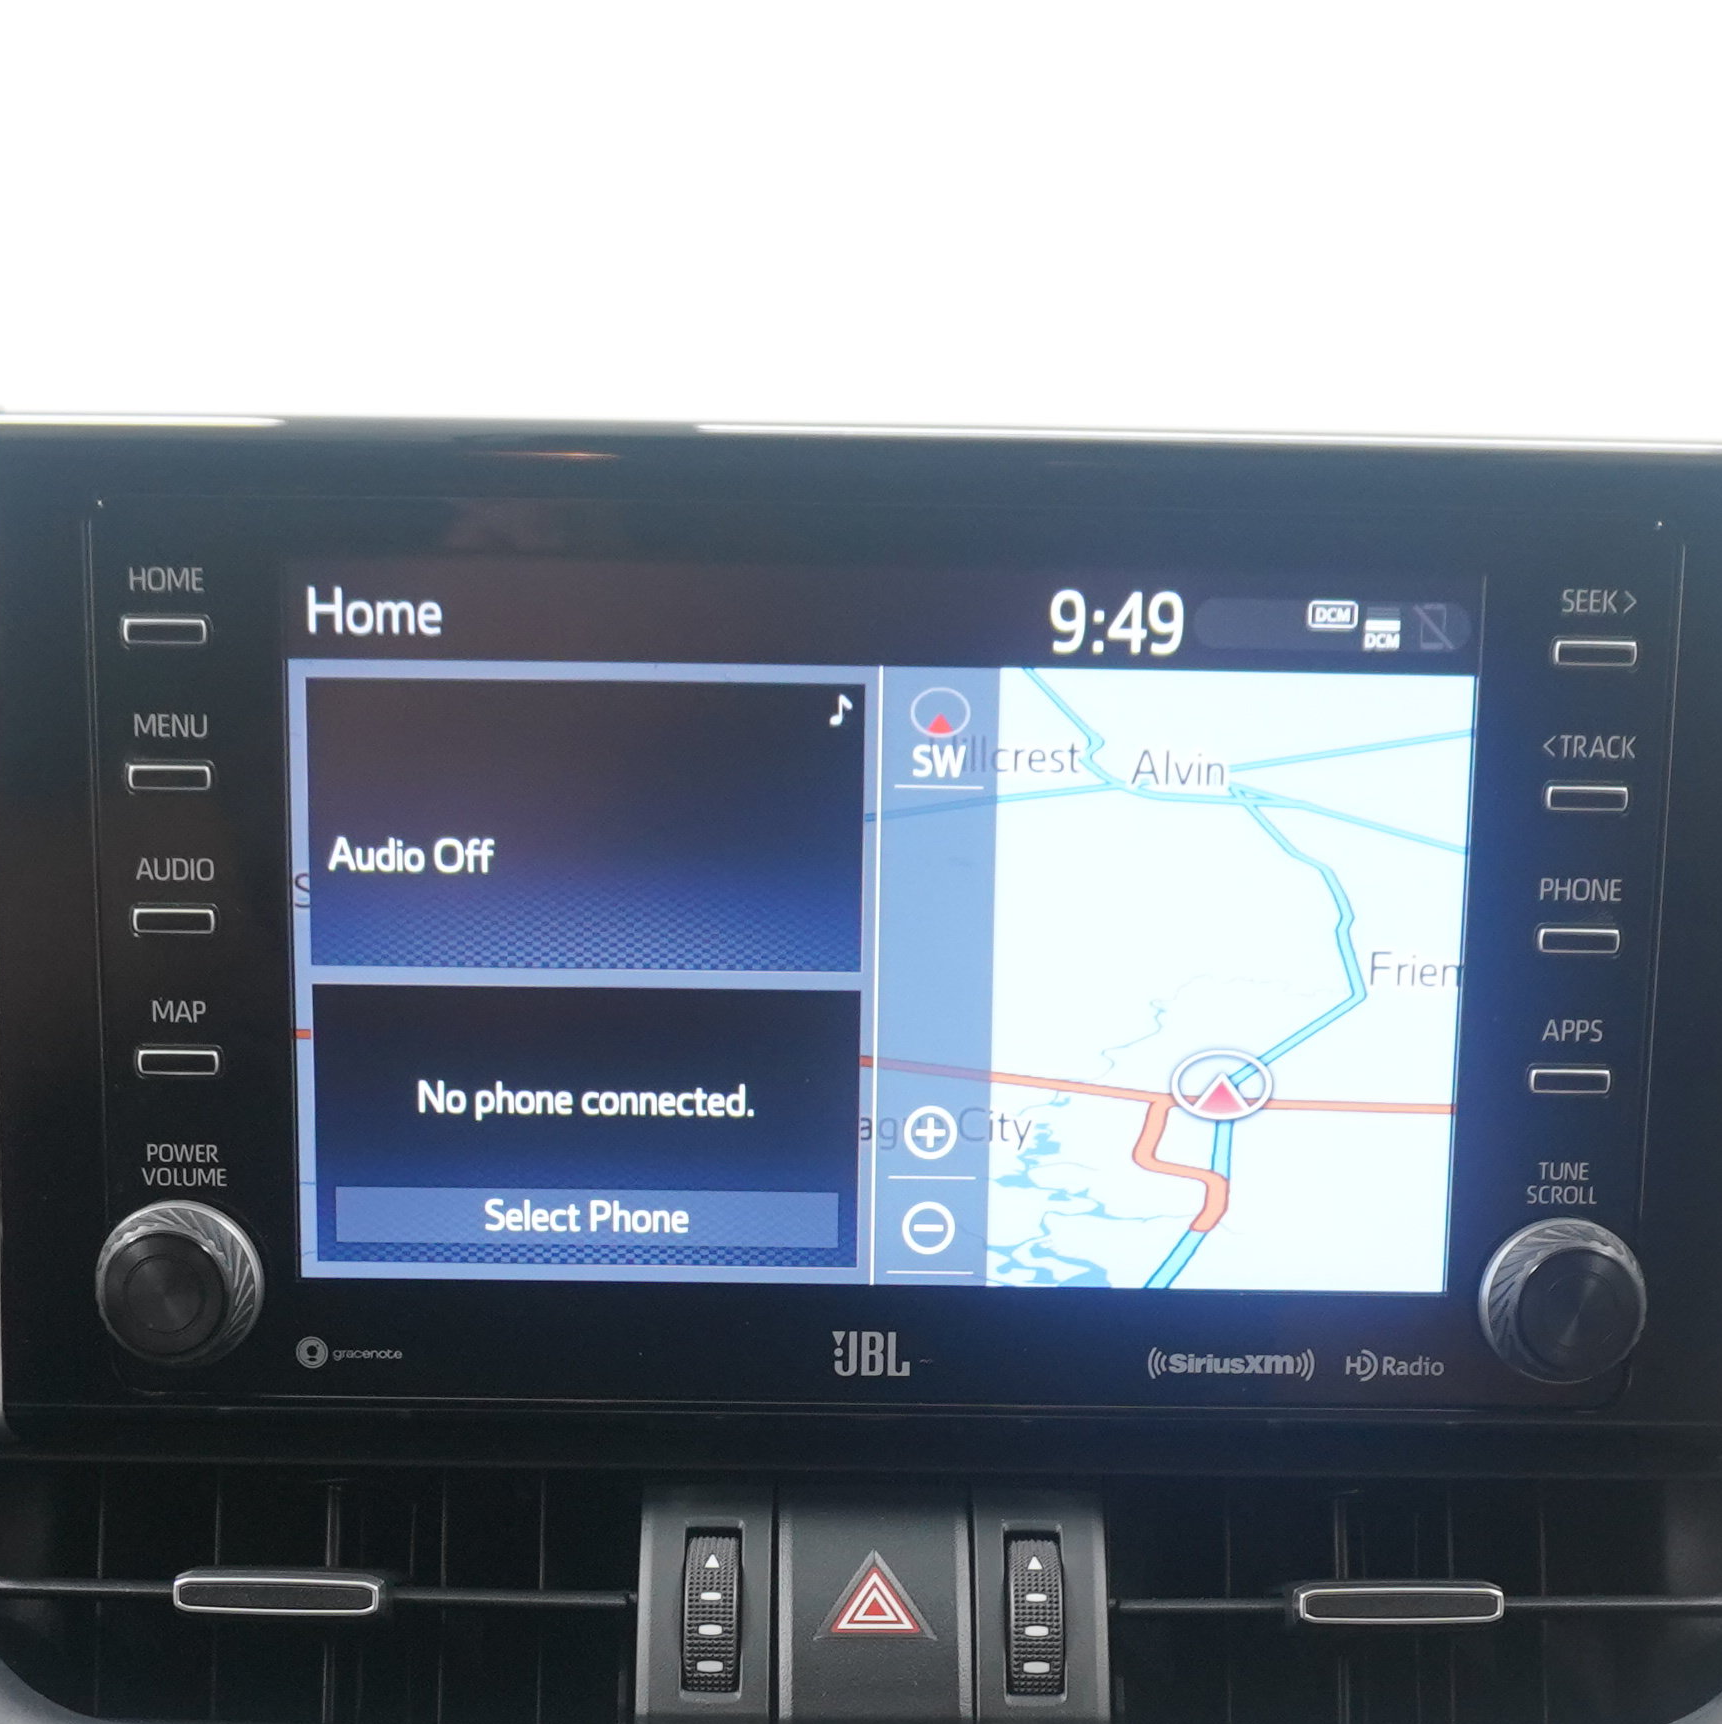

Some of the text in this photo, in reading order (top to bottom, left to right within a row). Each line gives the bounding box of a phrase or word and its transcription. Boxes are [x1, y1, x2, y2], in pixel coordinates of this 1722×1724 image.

[128, 566, 204, 593] HOME
[306, 586, 443, 638] Home
[1048, 589, 1186, 656] 9:49
[1313, 606, 1351, 622] DCM
[1363, 632, 1400, 649] DCM
[133, 712, 209, 739] MENU
[911, 743, 967, 778] SW
[1131, 748, 1227, 788] Alvin
[135, 856, 215, 883] AUDIO
[327, 838, 496, 875] Audio Off
[1539, 877, 1623, 904] PHONE
[150, 1000, 207, 1023] MAP
[1541, 1019, 1604, 1044] APPS
[416, 1081, 755, 1121] No phone connected.
[959, 1107, 1032, 1151] City
[146, 1143, 220, 1164] POWER
[141, 1167, 229, 1188] VOLUME
[1538, 1161, 1590, 1181] TUNE
[1526, 1184, 1598, 1206] SCROLL
[484, 1198, 690, 1237] Select Phone
[332, 1349, 403, 1362] gracenote
[831, 1330, 911, 1377] JBL
[1381, 1356, 1445, 1377] Radio
